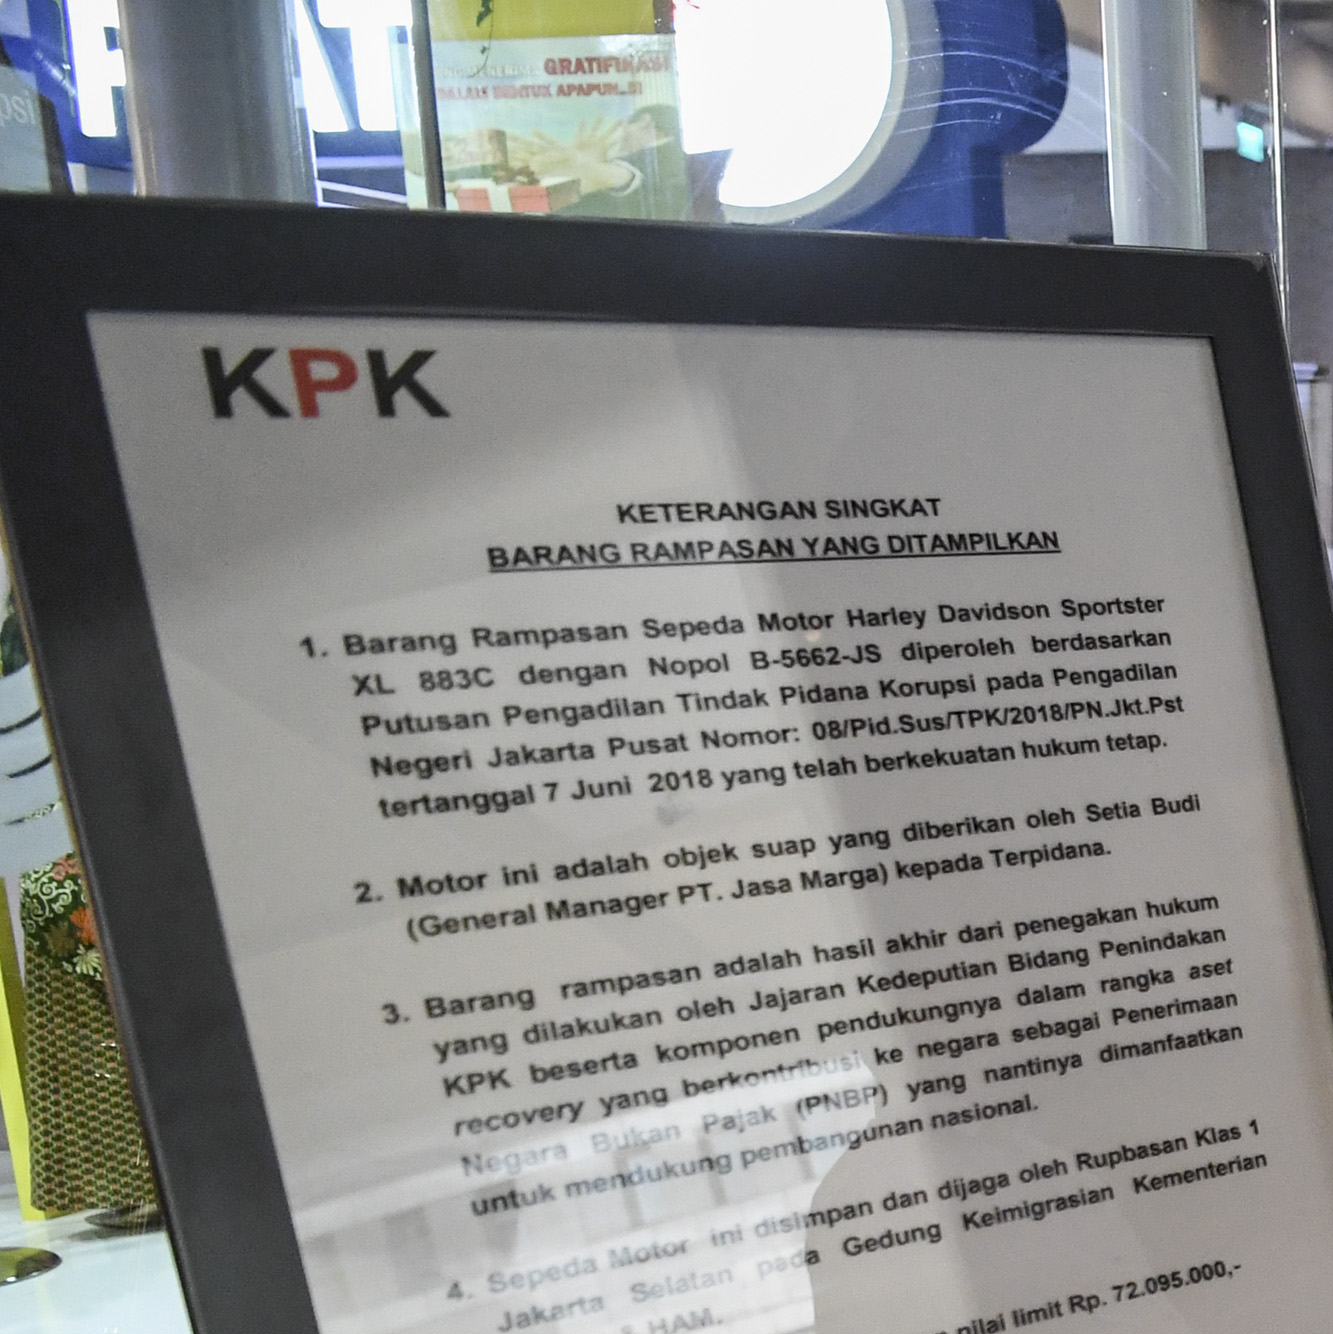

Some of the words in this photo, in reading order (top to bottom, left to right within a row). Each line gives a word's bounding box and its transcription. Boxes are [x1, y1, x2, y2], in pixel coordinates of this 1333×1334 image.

[200, 345, 452, 420] KPK
[485, 541, 622, 568] BARANG
[628, 536, 795, 564] RAMPASAN
[800, 533, 880, 558] YANG
[885, 529, 1060, 555] DITAMPILKAN
[615, 499, 818, 524] KETERANGAN
[823, 496, 941, 520] SINGKAT
[298, 635, 328, 658] 1.
[341, 632, 458, 656] Barang
[469, 623, 629, 649] Rampasan
[640, 613, 745, 642] Sepeda
[756, 611, 834, 632] Motor
[844, 606, 927, 630] Harley
[936, 601, 1051, 624] Davidson
[1059, 595, 1165, 621] Sportster
[351, 673, 396, 697] XL
[417, 665, 495, 692] 883C
[517, 662, 628, 686] dengan
[646, 651, 730, 679] Nopol
[748, 642, 882, 671] B-5662-JS
[899, 635, 1016, 664] diperoleh
[1029, 629, 1172, 654] berdasarkan
[359, 710, 491, 737] Putusan
[501, 697, 666, 727] Pengadilan
[674, 687, 769, 713] Tindak
[777, 682, 870, 706] Pidana
[877, 672, 977, 699] Korupsi
[984, 669, 1044, 696] pada
[1050, 662, 1178, 689] Pengadilan
[368, 748, 473, 778] Negeri
[486, 741, 596, 768] Jakarta
[606, 732, 689, 758] Pusat
[699, 726, 800, 749] Nomor:
[810, 694, 1185, 741] 08/Pid.Sus/TPK/2018/PN.Jkt.Pst
[377, 782, 536, 819] tertanggal
[542, 780, 559, 802] 7
[570, 774, 632, 801] Juni
[646, 767, 714, 793] 2018
[719, 765, 787, 792] yang
[791, 755, 858, 780] telah
[862, 744, 1016, 773] berkekuatan
[1019, 737, 1101, 759] hukum
[1104, 732, 1168, 753] tetap.
[352, 880, 383, 904] 2.
[395, 872, 488, 898] Motor
[500, 862, 540, 887] ini
[552, 850, 650, 882] adalah
[661, 841, 739, 870] objek
[749, 836, 817, 859] suap
[827, 828, 892, 856] yang
[900, 815, 1016, 842] diberikan
[1024, 806, 1076, 829] oleh
[1084, 800, 1142, 823] Setia
[1149, 792, 1201, 816] Budi
[405, 902, 537, 942] (General
[543, 890, 670, 921] Manager
[675, 881, 723, 905] PT.
[729, 876, 793, 900] Jasa
[798, 861, 889, 890] Marga)
[893, 851, 984, 881] kepada
[987, 840, 1112, 869] Terpidana.
[380, 1001, 410, 1025] 3.
[422, 988, 536, 1019] Barang
[558, 964, 702, 1000] rampasan
[712, 947, 802, 979] adalah
[811, 936, 876, 964] hasil
[884, 928, 948, 954] akhir
[956, 919, 1004, 944] dari
[1012, 905, 1138, 941] penegakan
[1144, 894, 1220, 918] hukum
[432, 1031, 510, 1062] yang
[521, 1009, 664, 1045] dilakukan
[674, 995, 736, 1022] oleh
[747, 981, 846, 1012] Jajaran
[855, 959, 998, 995] Kedeputian
[1006, 946, 1090, 973] Bidang
[1097, 927, 1227, 959] Penindakan
[441, 1067, 512, 1098] KPK
[527, 1051, 639, 1084] beserta
[653, 1026, 801, 1063] komponen
[815, 994, 1002, 1043] pendukungnya
[1014, 982, 1087, 1007] dalam
[1098, 967, 1175, 994] rangka
[1187, 957, 1233, 980] aset
[453, 1097, 585, 1137] recovery
[599, 1085, 669, 1119] yang
[682, 1051, 863, 1098] berkontribusi
[872, 1046, 904, 1065] ke
[915, 1030, 1000, 1059] negara
[1010, 1010, 1101, 1044] sebagai
[1110, 991, 1238, 1026] Penerimaan
[459, 1142, 569, 1173] Negara
[589, 1122, 682, 1154] Bukan
[701, 1104, 777, 1135] Pajak
[794, 1082, 889, 1114] (PNBP)
[905, 1073, 967, 1102] yang
[982, 1052, 1084, 1084] nantinya
[1097, 1025, 1244, 1064] dimanfaatkan
[469, 1182, 556, 1216] untuk
[563, 1153, 732, 1198] mendukung
[738, 1116, 924, 1169] pembangunan
[929, 1092, 1039, 1130] nasional.
[446, 1279, 474, 1303] 4.
[485, 1255, 600, 1294] Sepeda
[608, 1239, 688, 1269] Motor
[708, 1226, 744, 1248] ini
[752, 1200, 874, 1238] disimpan
[880, 1188, 929, 1212] dan
[935, 1171, 1011, 1201] dijaga
[1017, 1157, 1069, 1184] oleh
[1074, 1135, 1188, 1171] Rupbasan
[1193, 1125, 1242, 1147] Klas
[1247, 1117, 1259, 1136] 1
[496, 1294, 605, 1334] Jakarta
[628, 1266, 734, 1303] Selatan
[755, 1248, 821, 1280] pada
[841, 1222, 943, 1257] Gedung
[960, 1185, 1115, 1231] Keimigrasian
[1131, 1152, 1268, 1194] Kementerian
[1010, 1299, 1064, 1328] limit
[1067, 1293, 1108, 1314] Rp.
[1110, 1259, 1242, 1302] 72.095.000,-
